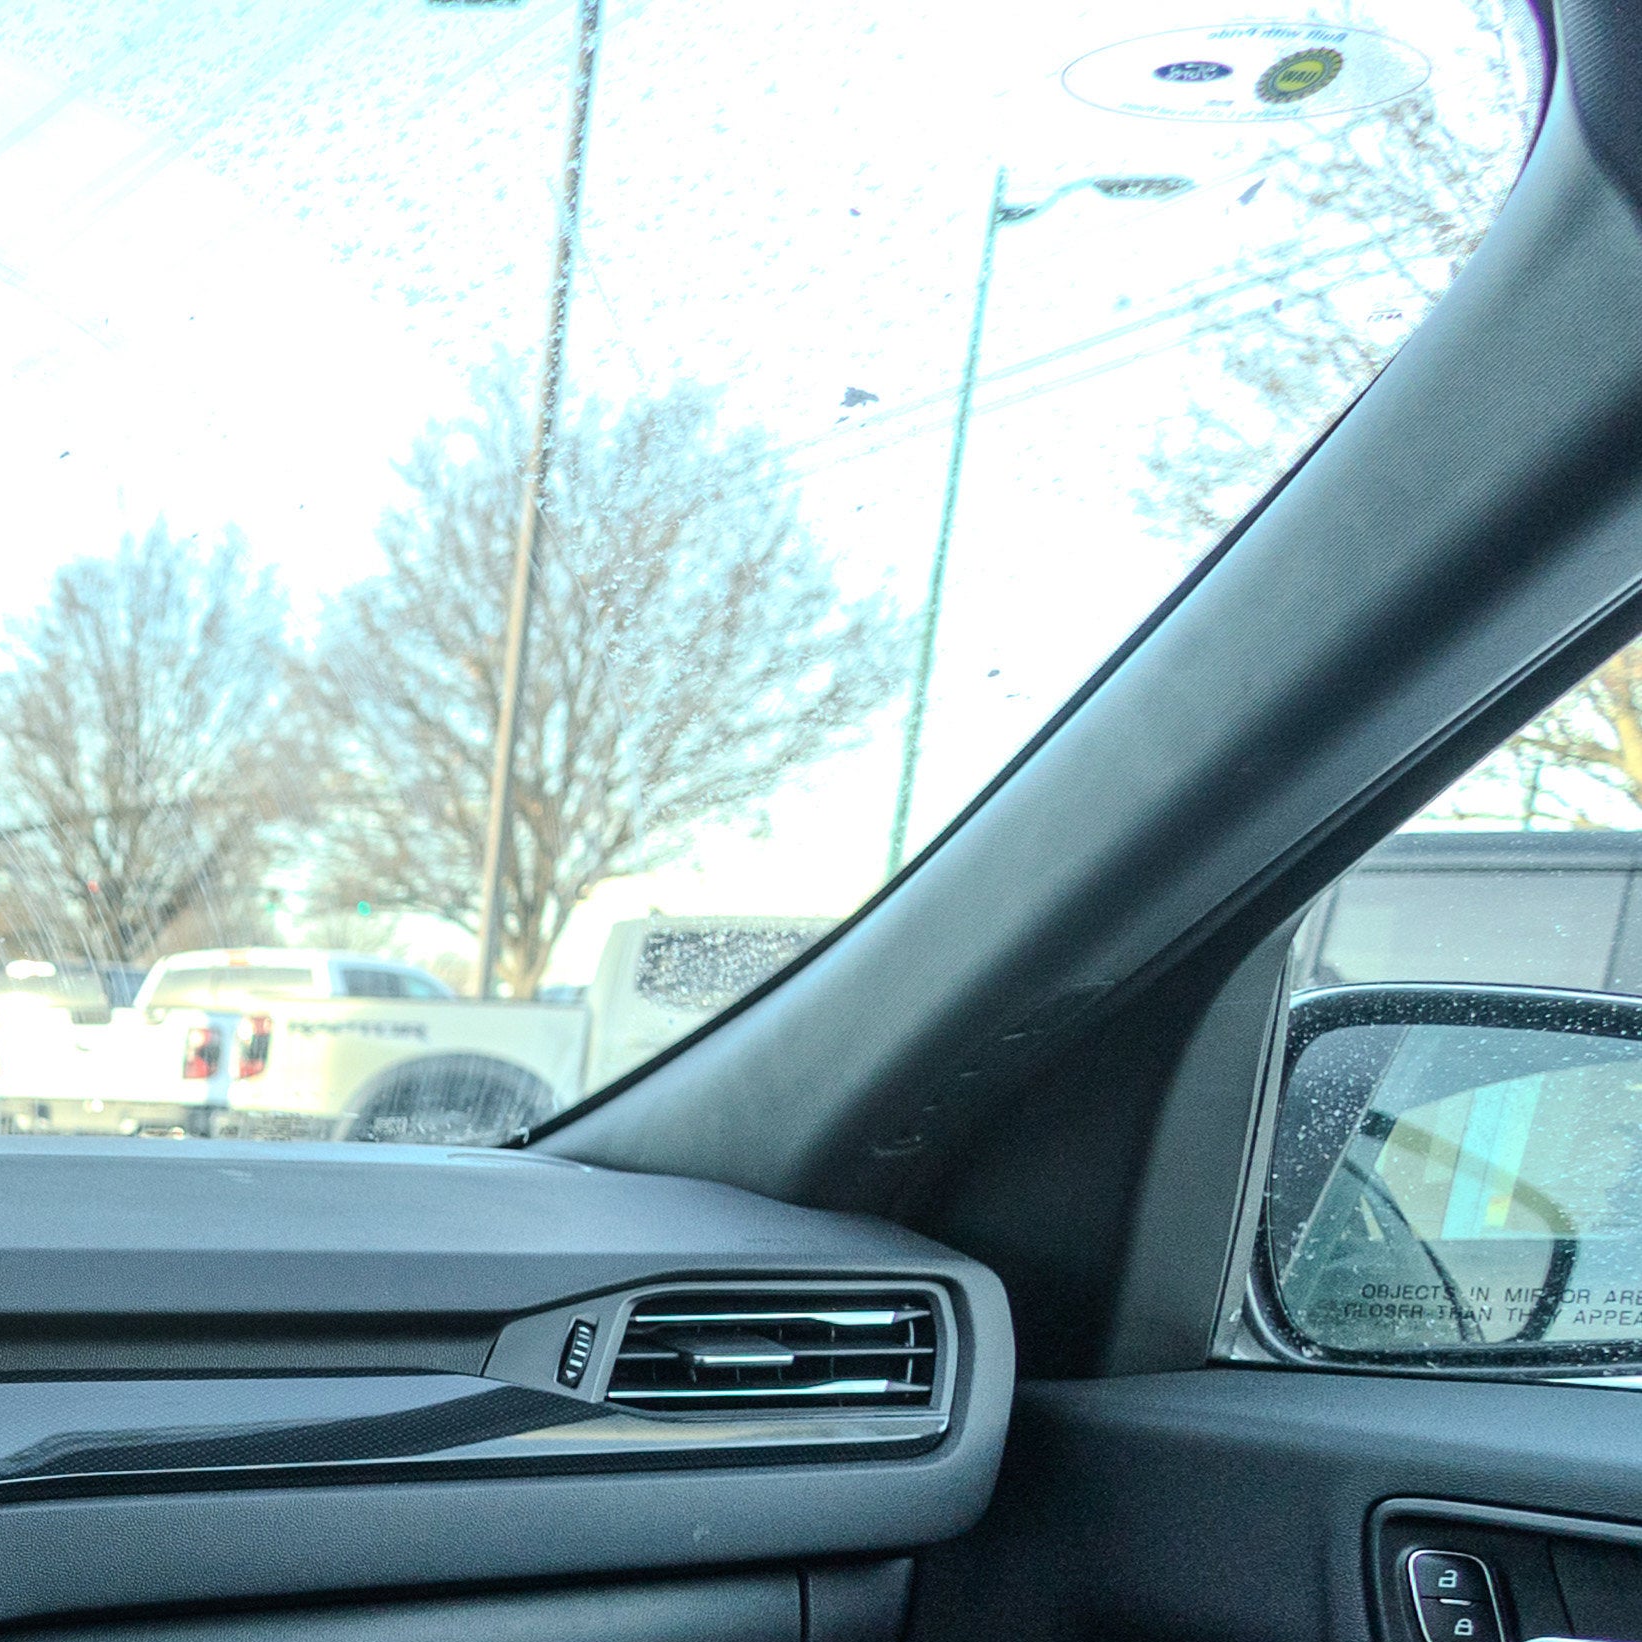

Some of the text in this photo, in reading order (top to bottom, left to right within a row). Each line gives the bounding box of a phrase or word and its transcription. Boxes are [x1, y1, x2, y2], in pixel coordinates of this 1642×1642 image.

[1361, 1284, 1455, 1301] OBJECTS
[1469, 1287, 1490, 1301] IN
[1504, 1287, 1591, 1304] MIROR
[1344, 1302, 1423, 1320] CLOSER
[1507, 1307, 1561, 1323] THY
